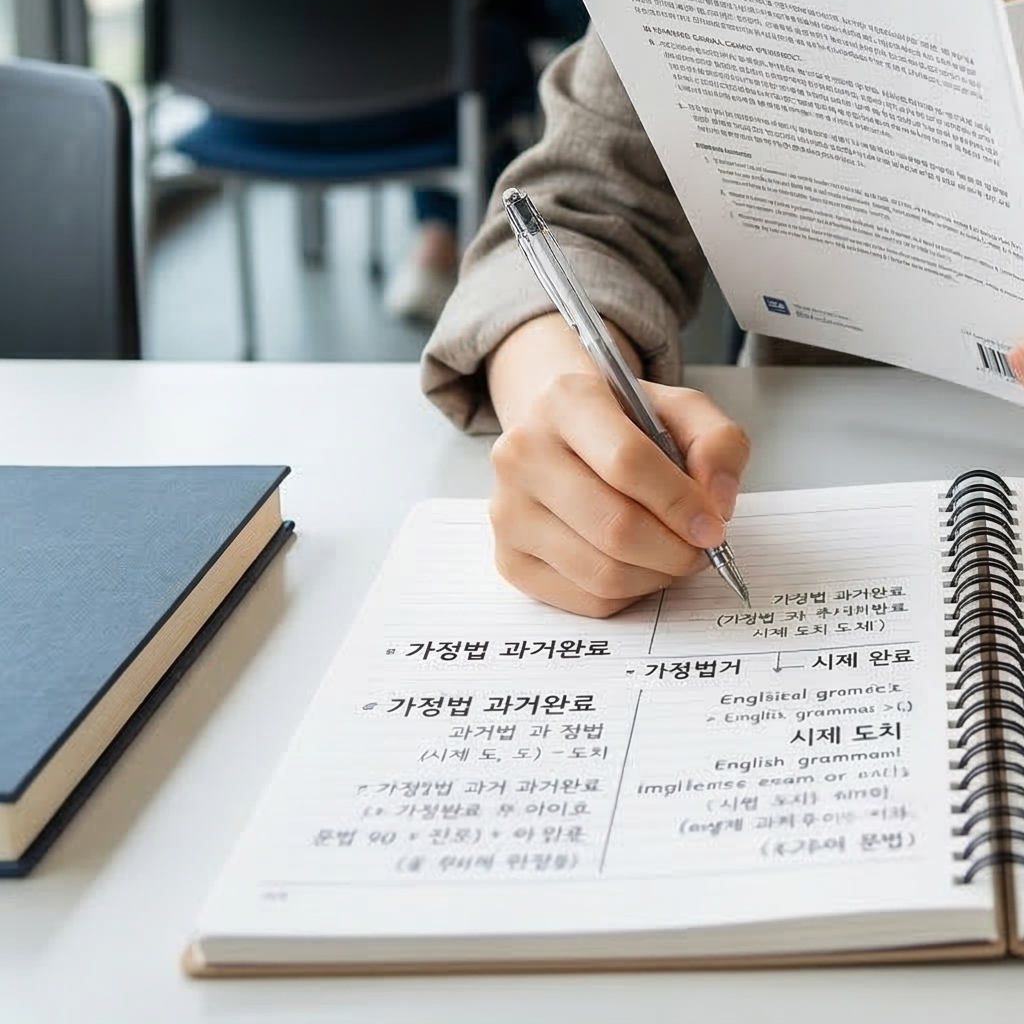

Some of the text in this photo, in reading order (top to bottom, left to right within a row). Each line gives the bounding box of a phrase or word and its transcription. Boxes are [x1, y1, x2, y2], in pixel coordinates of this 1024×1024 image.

[405, 639, 612, 661] 가정법 과거완료
[811, 648, 915, 671] 시제 완료
[645, 659, 742, 680] 가정법거
[387, 693, 597, 717] 가정법 과거완료
[790, 722, 901, 746] 시제 도치
[714, 757, 785, 773] English
